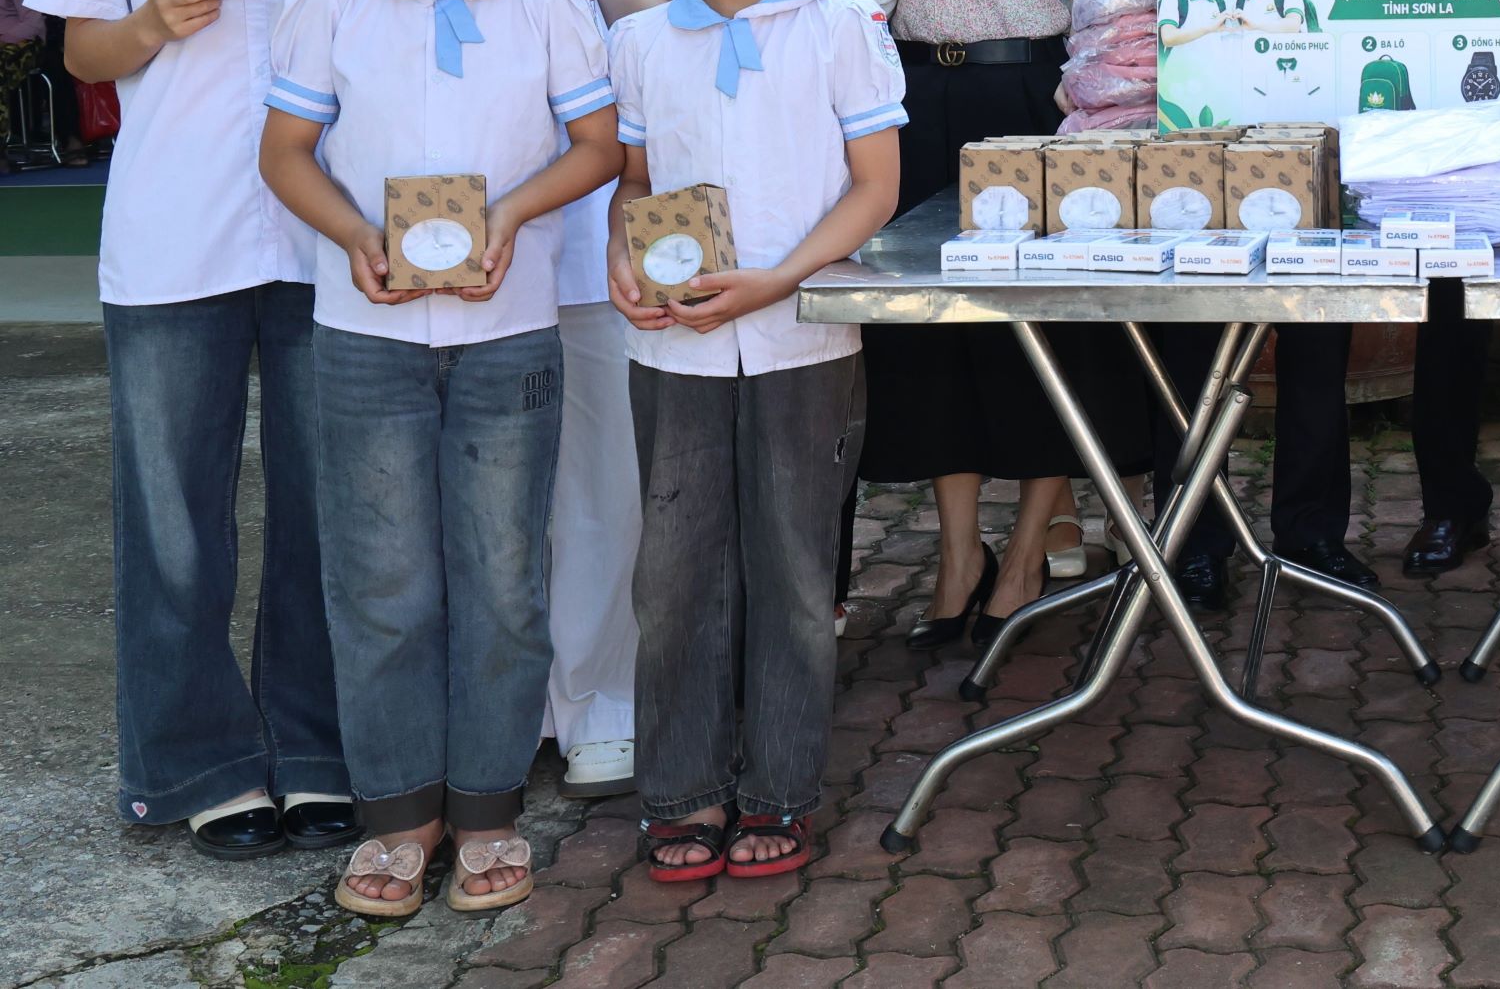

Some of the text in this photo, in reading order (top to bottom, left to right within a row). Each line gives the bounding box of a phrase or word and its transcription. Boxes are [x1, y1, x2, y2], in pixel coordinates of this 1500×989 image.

[1412, 3, 1436, 15] SƠN
[1439, 3, 1454, 14] LA
[1258, 40, 1265, 51] 1
[1308, 42, 1329, 52] PHỤC
[1366, 39, 1405, 49] 2 BA LÔ
[1456, 37, 1463, 48] 3
[1386, 232, 1418, 240] CASIO
[1093, 254, 1124, 262] CASIO
[1161, 248, 1175, 263] CAS
[1347, 259, 1378, 267] CASIO
[1425, 261, 1457, 269] CASIO
